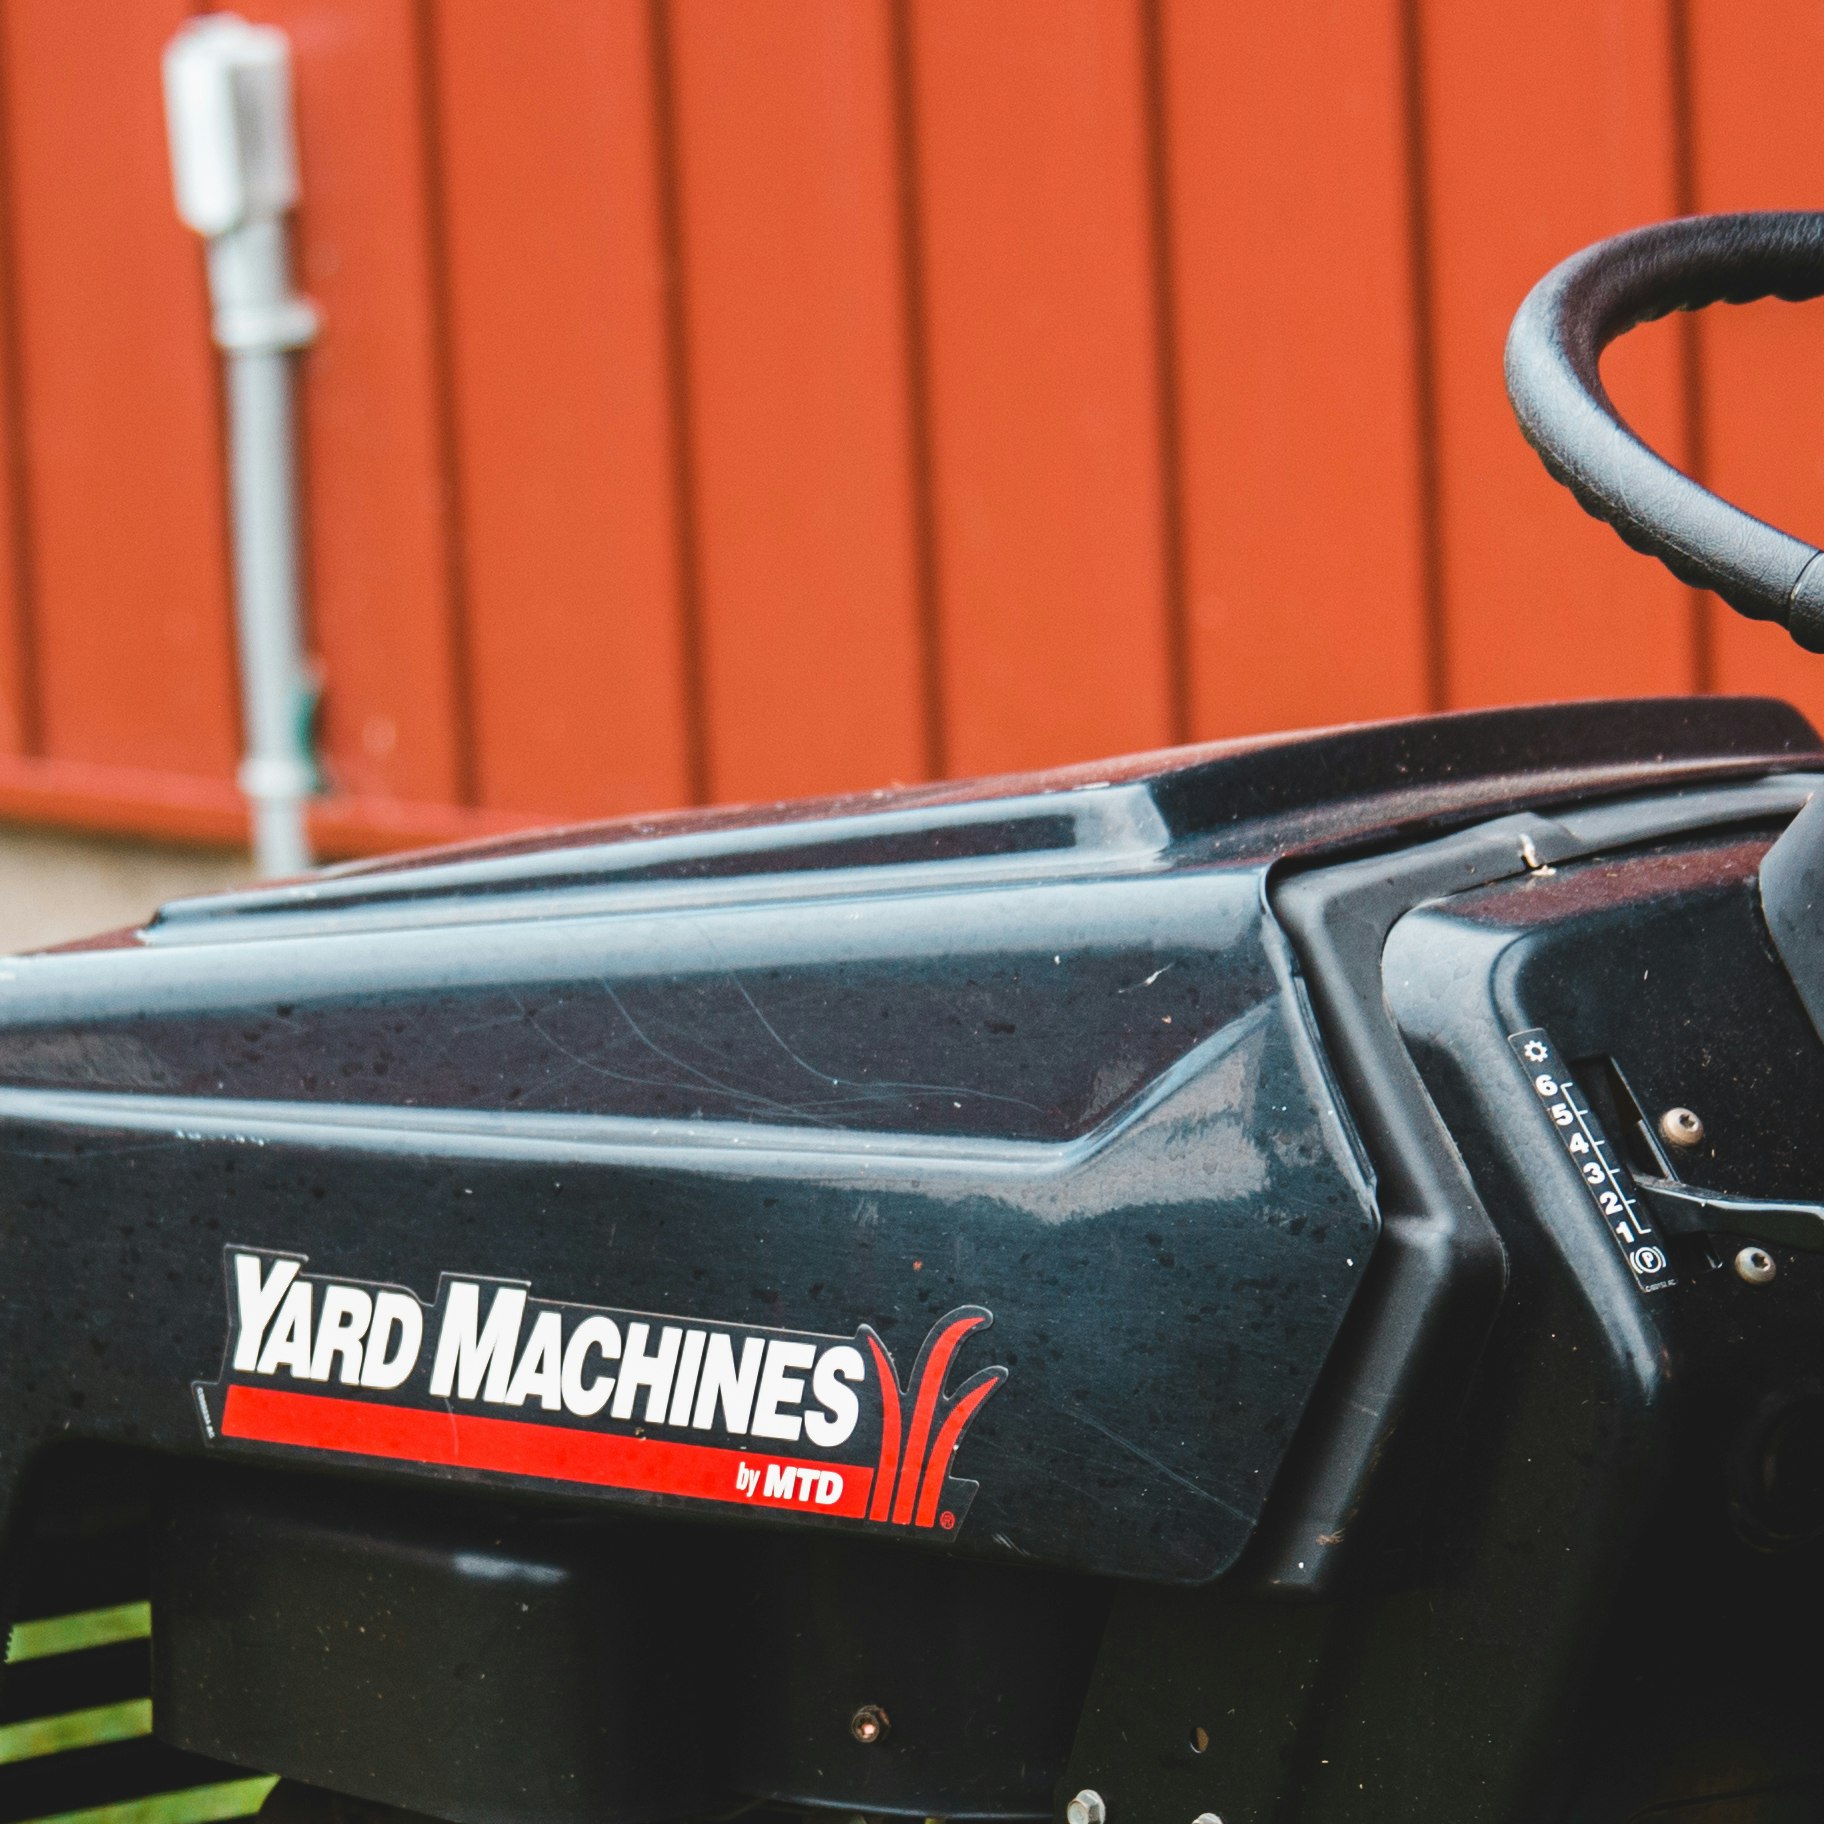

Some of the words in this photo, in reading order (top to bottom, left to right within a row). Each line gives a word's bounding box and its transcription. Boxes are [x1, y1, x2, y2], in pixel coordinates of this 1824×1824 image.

[1535, 1074, 1558, 1096] 6
[1551, 1103, 1574, 1126] 5
[1568, 1133, 1589, 1155] 4
[1583, 1163, 1605, 1185] 3
[1599, 1191, 1624, 1216] 2
[1615, 1221, 1635, 1244] 1
[1642, 1252, 1656, 1267] P
[230, 1253, 425, 1392] YARD
[430, 1282, 868, 1448] MACHINES
[734, 1460, 763, 1498] by
[763, 1464, 845, 1506] MTD
